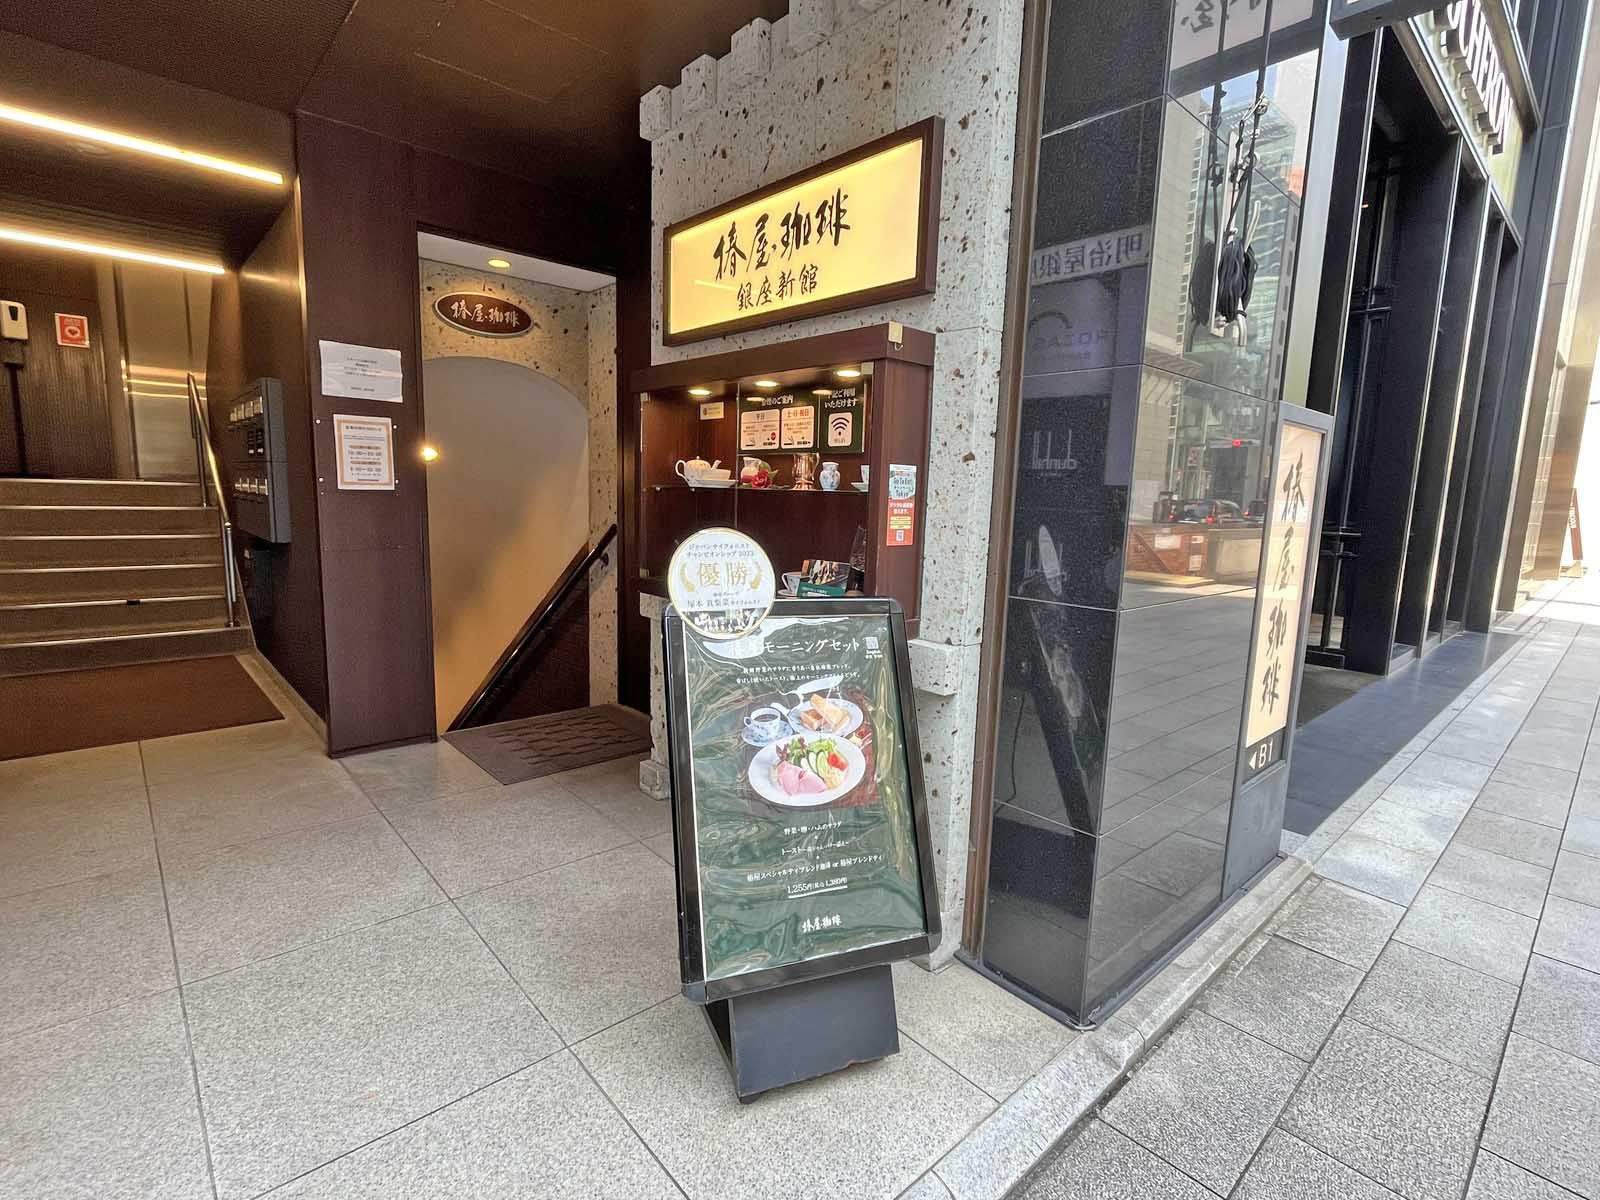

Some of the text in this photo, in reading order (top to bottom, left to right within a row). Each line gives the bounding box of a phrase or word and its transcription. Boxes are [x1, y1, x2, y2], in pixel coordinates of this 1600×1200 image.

[736, 263, 819, 311] 銀座新館
[824, 397, 857, 409] いただけます
[697, 560, 748, 587] 優勝
[1258, 737, 1274, 769] B1
